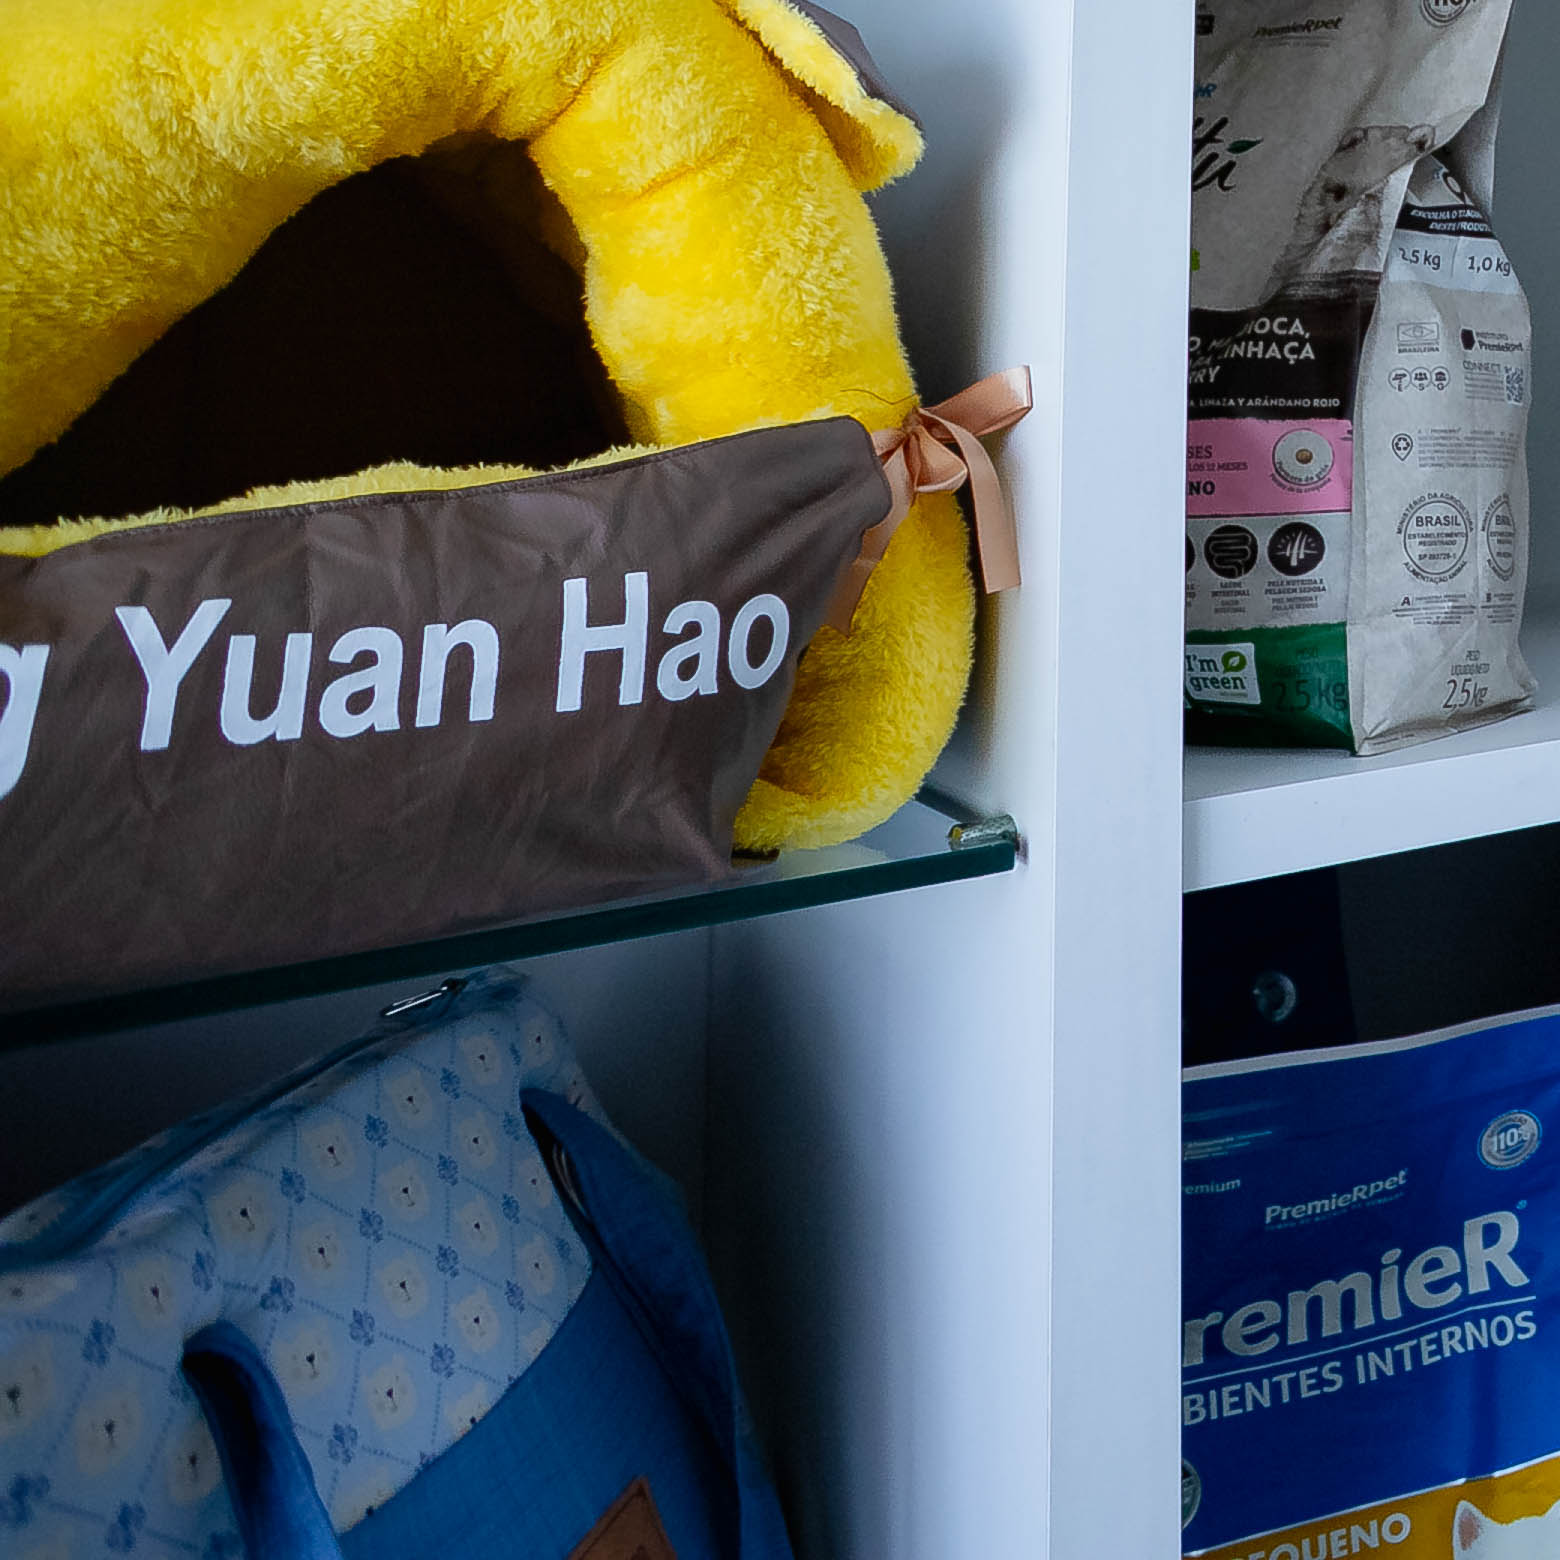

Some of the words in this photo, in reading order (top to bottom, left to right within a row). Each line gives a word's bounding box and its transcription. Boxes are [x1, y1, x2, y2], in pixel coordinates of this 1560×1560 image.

[1424, 250, 1441, 271] kg
[1468, 256, 1492, 273] 1,0
[1495, 258, 1511, 277] kg
[1247, 396, 1310, 408] ARÁNDANO
[1415, 515, 1461, 527] BRASIL
[114, 596, 500, 752] Yuan
[554, 570, 793, 714] Hao
[1190, 676, 1246, 691] green
[1184, 1178, 1241, 1194] emium
[1265, 1171, 1407, 1224] PremieRpet
[1181, 1208, 1531, 1369] remieR
[1182, 1359, 1345, 1427] BIENTES
[1356, 1310, 1537, 1385] INTERNOS
